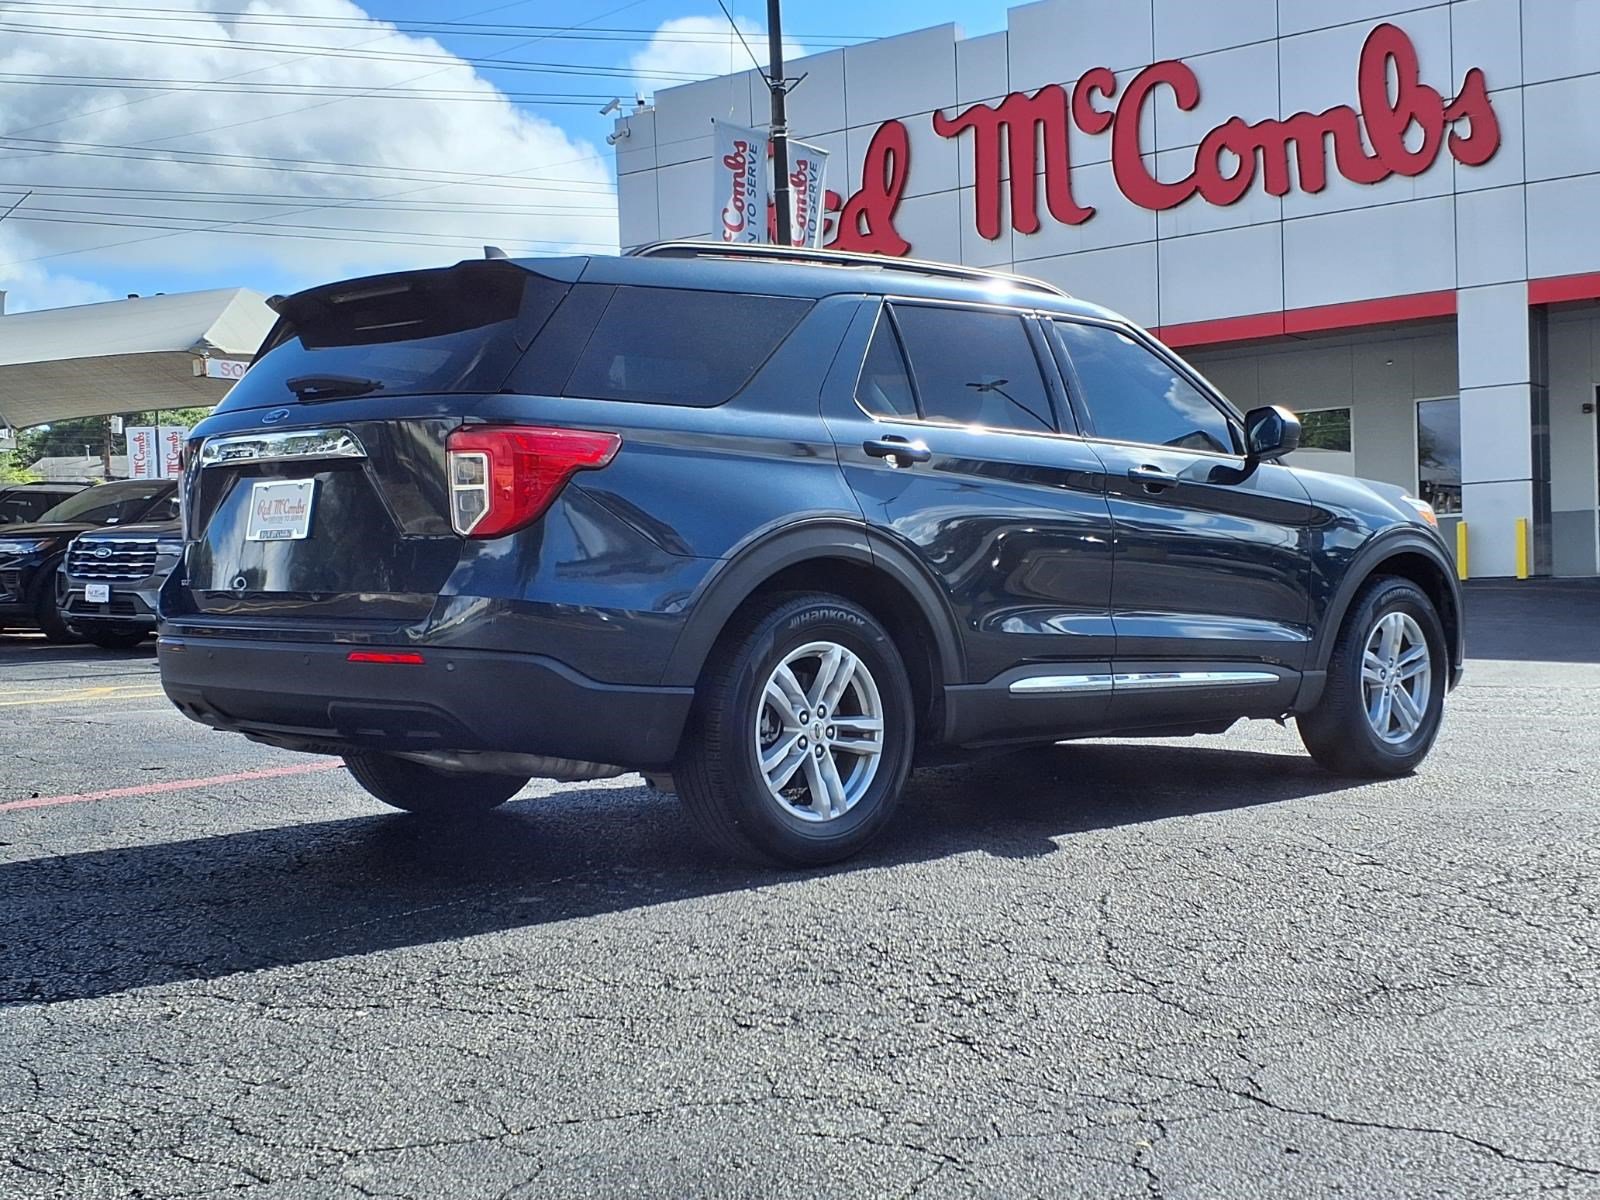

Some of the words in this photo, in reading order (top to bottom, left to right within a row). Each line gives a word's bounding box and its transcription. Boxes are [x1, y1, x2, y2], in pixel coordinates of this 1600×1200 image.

[933, 23, 1500, 241] McCombs
[722, 141, 747, 242] cCombs
[747, 143, 758, 199] SERVE
[808, 161, 818, 214] SERVE
[747, 204, 757, 227] TO
[807, 219, 817, 241] TO
[221, 362, 247, 378] SO
[133, 431, 146, 477] McCombs
